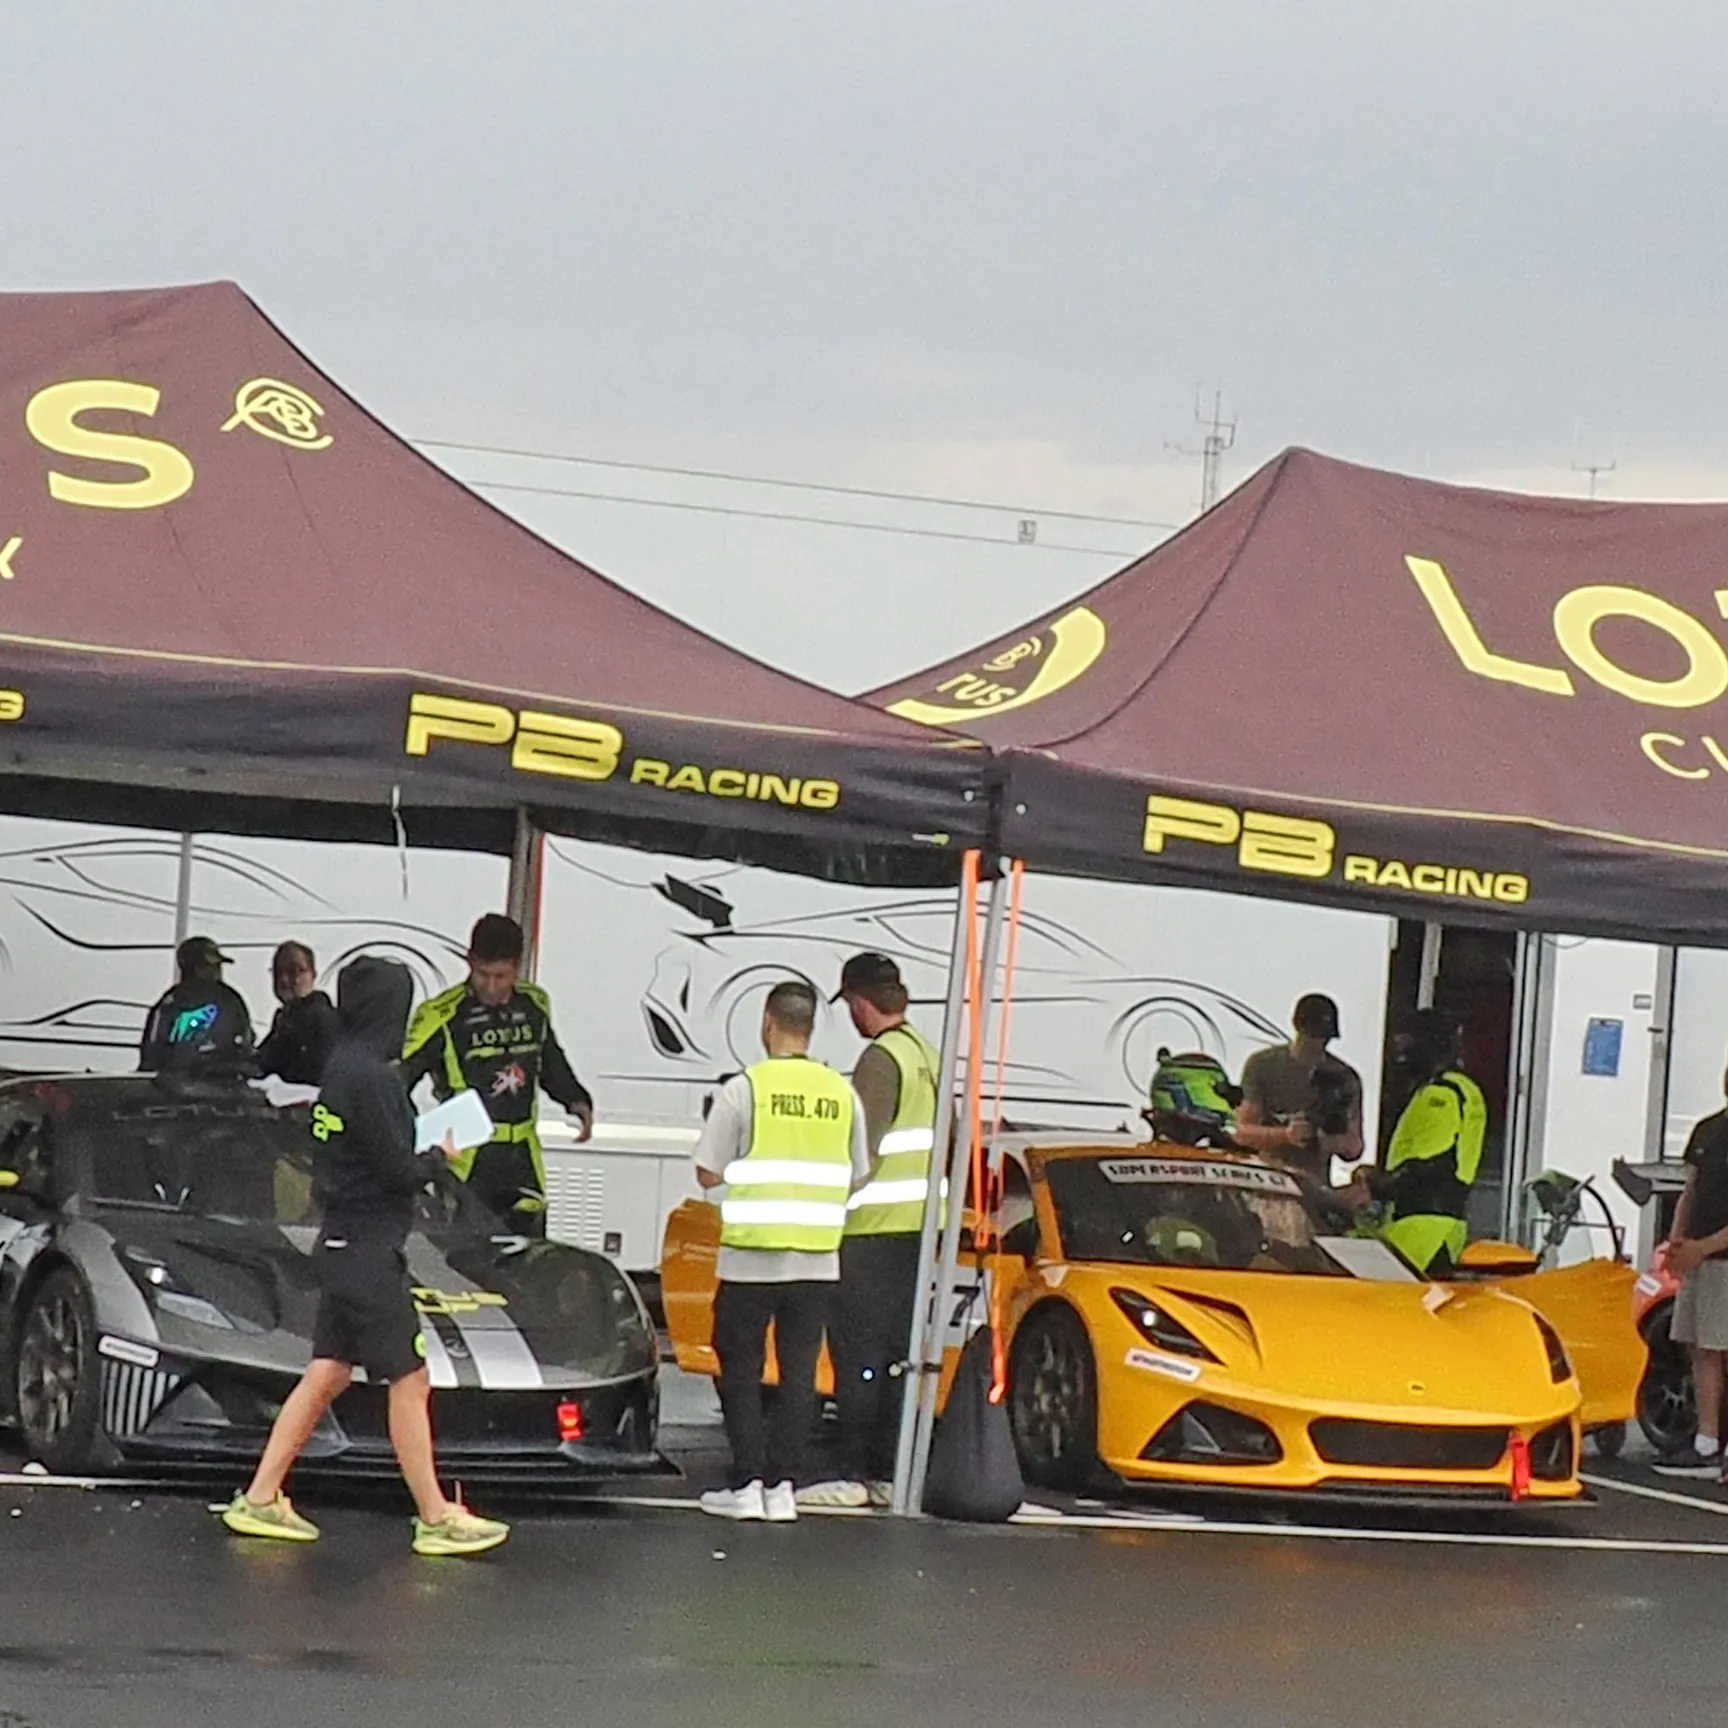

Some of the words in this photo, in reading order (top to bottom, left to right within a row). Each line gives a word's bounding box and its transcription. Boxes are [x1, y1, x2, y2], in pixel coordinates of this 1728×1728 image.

[935, 672, 1018, 706] TUS
[405, 693, 624, 781] PB
[629, 757, 840, 810] RACING
[1142, 794, 1336, 879] PB
[1342, 853, 1529, 904] RACING
